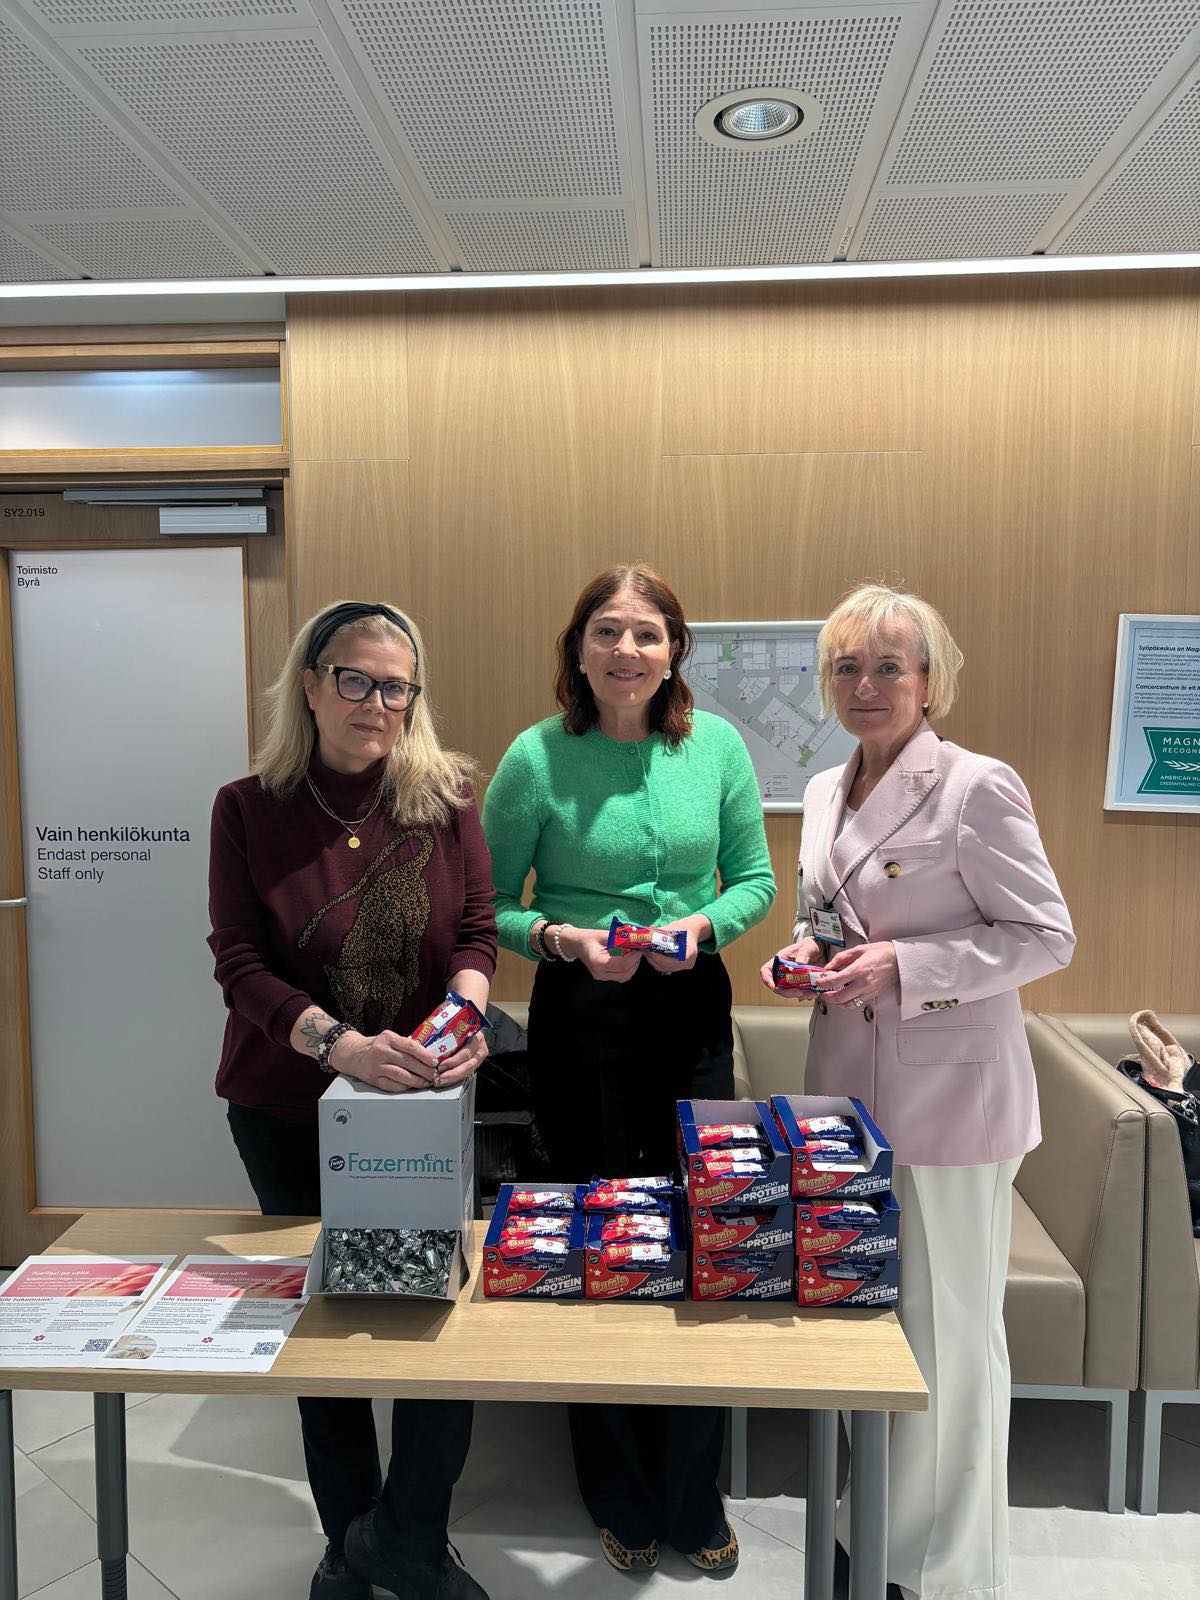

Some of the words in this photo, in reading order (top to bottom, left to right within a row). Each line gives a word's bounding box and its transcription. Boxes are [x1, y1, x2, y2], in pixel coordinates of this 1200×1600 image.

[4, 508, 45, 517] SY2.019
[16, 565, 58, 575] Toimisto
[17, 577, 40, 588] Byrå
[36, 826, 73, 842] Vain
[77, 826, 191, 842] henkilökunta
[37, 847, 86, 861] Endast
[91, 848, 151, 864] personal
[38, 867, 71, 880] Staff
[75, 867, 104, 884] only
[348, 1152, 455, 1173] Fazermint
[751, 1180, 779, 1192] CRUNCHY
[797, 1173, 837, 1193] Dumle
[844, 1177, 891, 1194] PROTEIN
[853, 1174, 882, 1185] CRUNCHY
[694, 1181, 734, 1202] Dumle
[742, 1183, 789, 1203] PROTEIN
[700, 1227, 738, 1248] Dumle
[746, 1231, 793, 1249] PROTEIN
[755, 1228, 783, 1239] CRUNCHY
[801, 1232, 842, 1252] Dumle
[858, 1234, 887, 1244] CRUNCHY
[850, 1237, 897, 1254] PROTEIN
[488, 1272, 527, 1293] Dumle
[536, 1276, 582, 1295] PROTEIN
[544, 1273, 572, 1285] CRUNCHY
[590, 1274, 630, 1294] Dumle
[637, 1278, 684, 1296] PROTEIN
[646, 1276, 674, 1287] CRUNCHY
[698, 1276, 737, 1296] Dumle
[754, 1276, 782, 1288] CRUNCHY
[745, 1279, 792, 1297] PROTEIN
[804, 1282, 844, 1303] Dumle
[851, 1286, 898, 1304] PROTEIN
[860, 1283, 889, 1294] CRUNCHY
